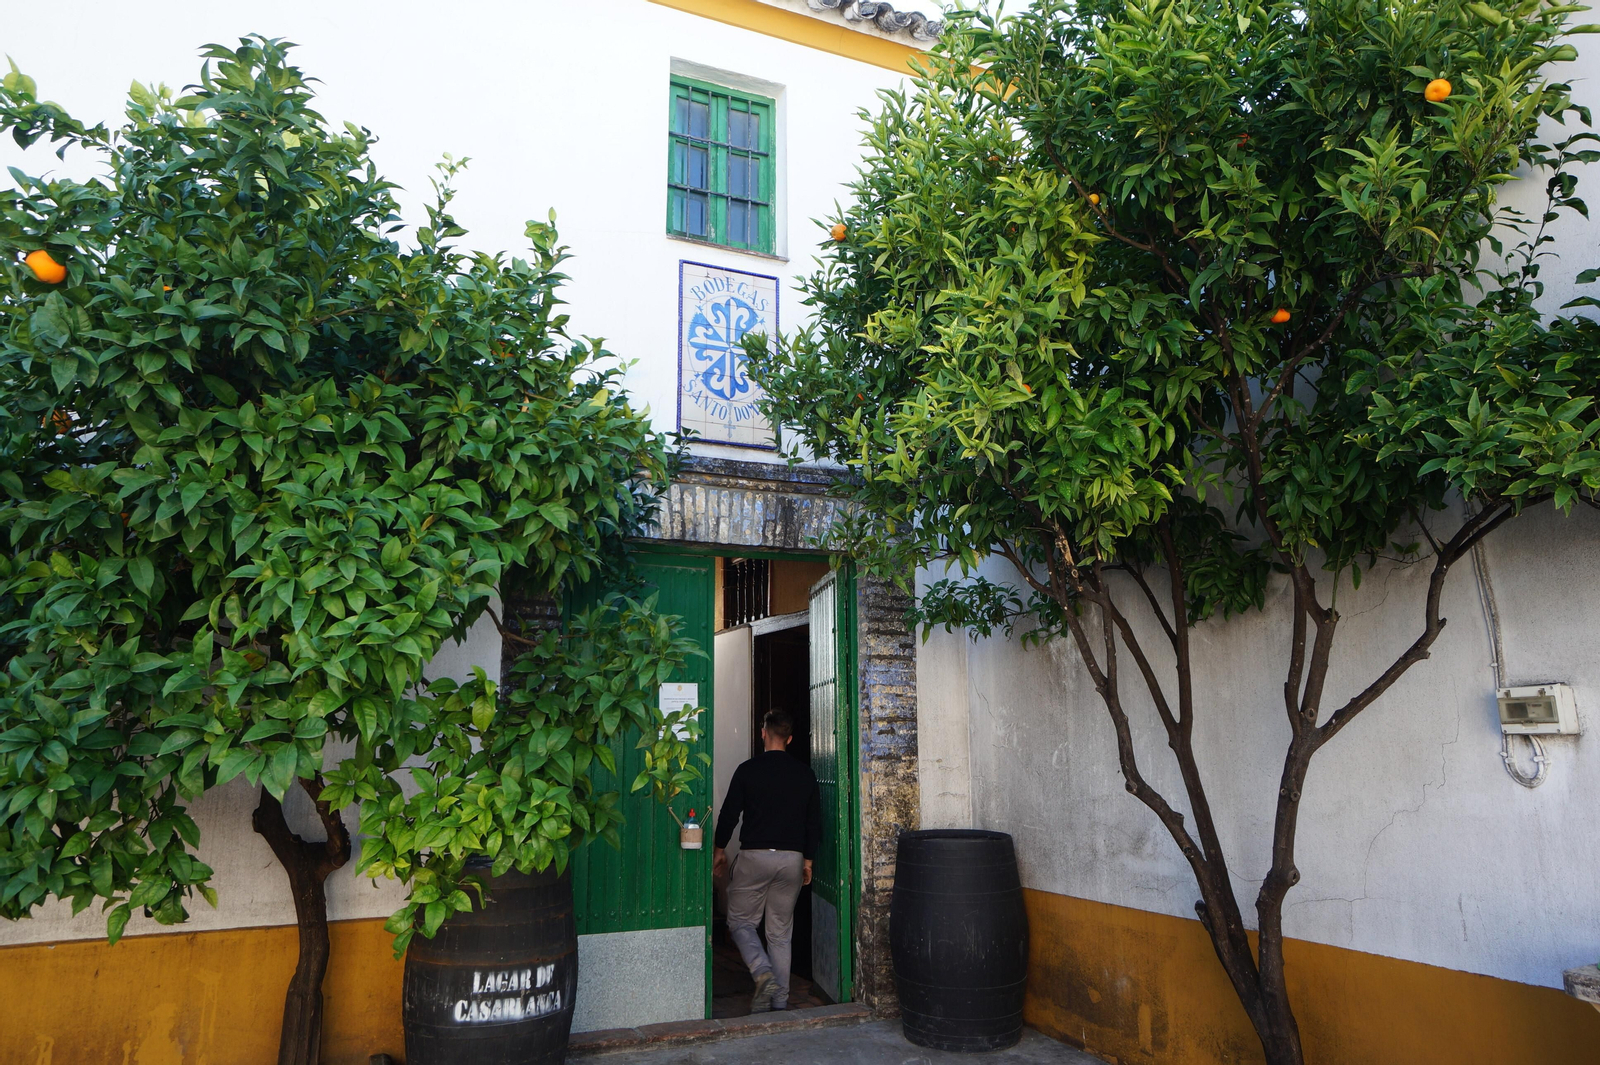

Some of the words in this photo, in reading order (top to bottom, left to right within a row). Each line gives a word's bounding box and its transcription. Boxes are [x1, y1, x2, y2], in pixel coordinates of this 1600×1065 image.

[690, 277, 769, 311] BODEGAS
[683, 379, 728, 420] SANTO
[473, 969, 532, 994] LAGAR
